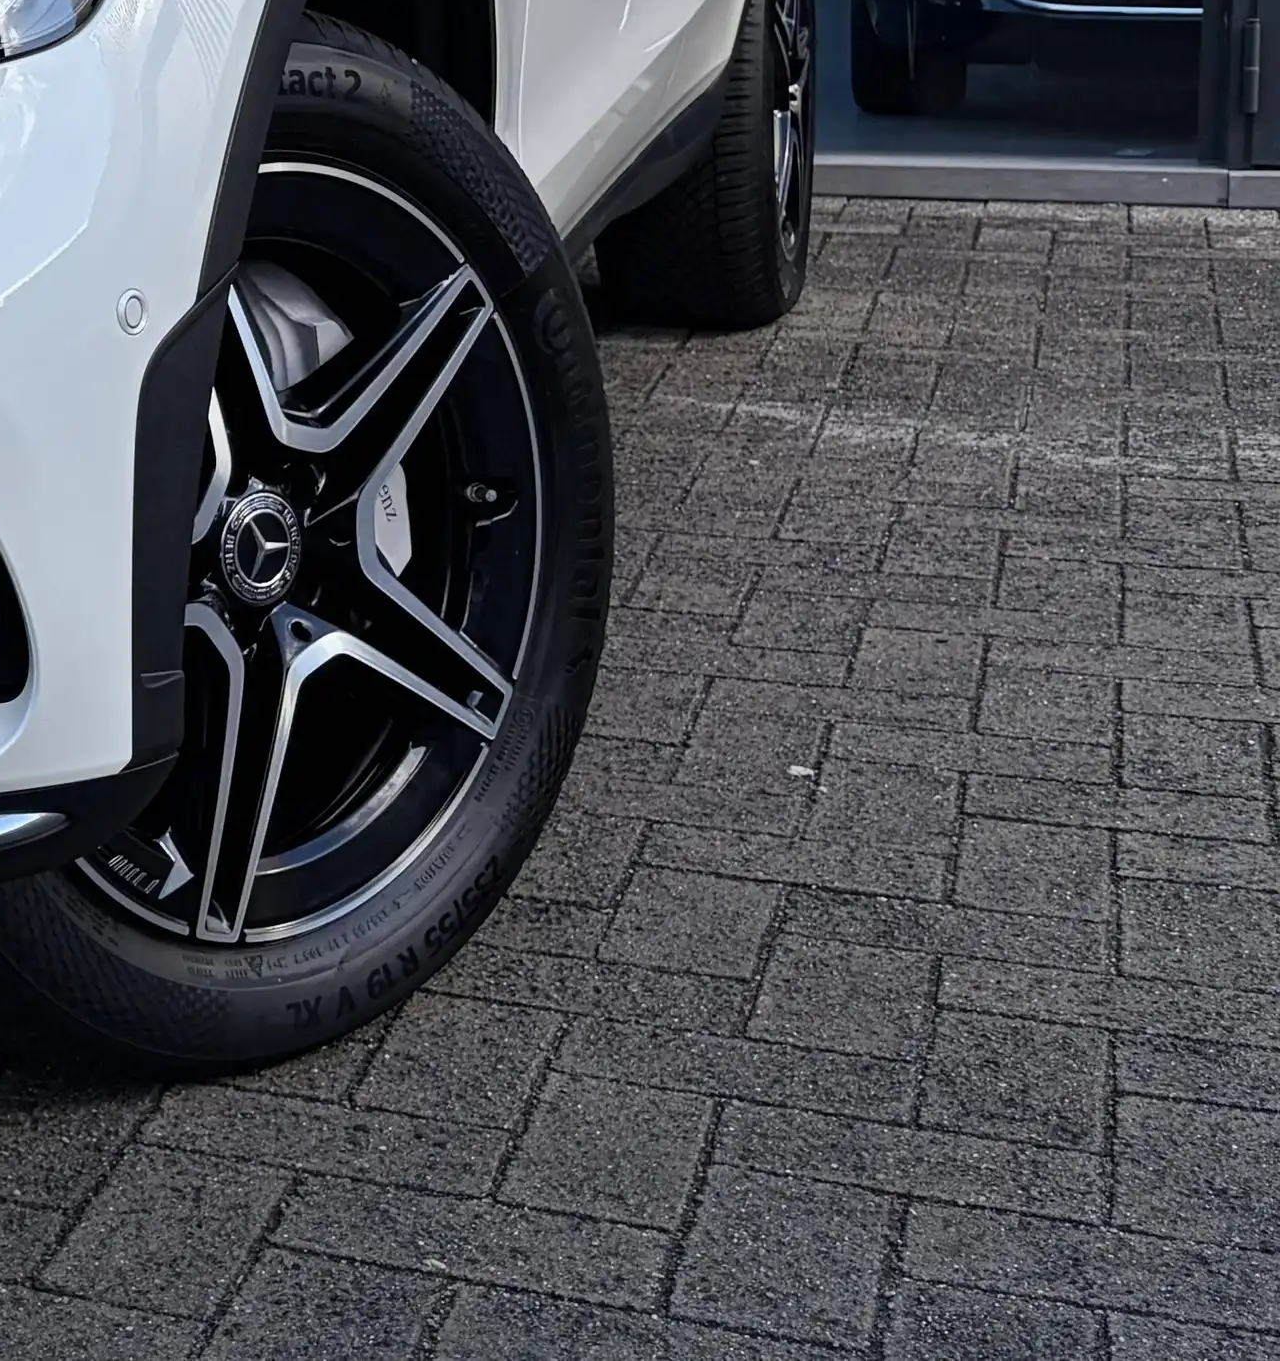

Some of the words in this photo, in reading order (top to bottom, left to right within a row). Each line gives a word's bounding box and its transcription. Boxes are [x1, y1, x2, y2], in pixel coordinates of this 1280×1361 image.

[344, 69, 362, 101] 2
[396, 945, 420, 978] R
[366, 962, 394, 1001] 19
[286, 994, 323, 1030] XL
[336, 984, 357, 1019] V
